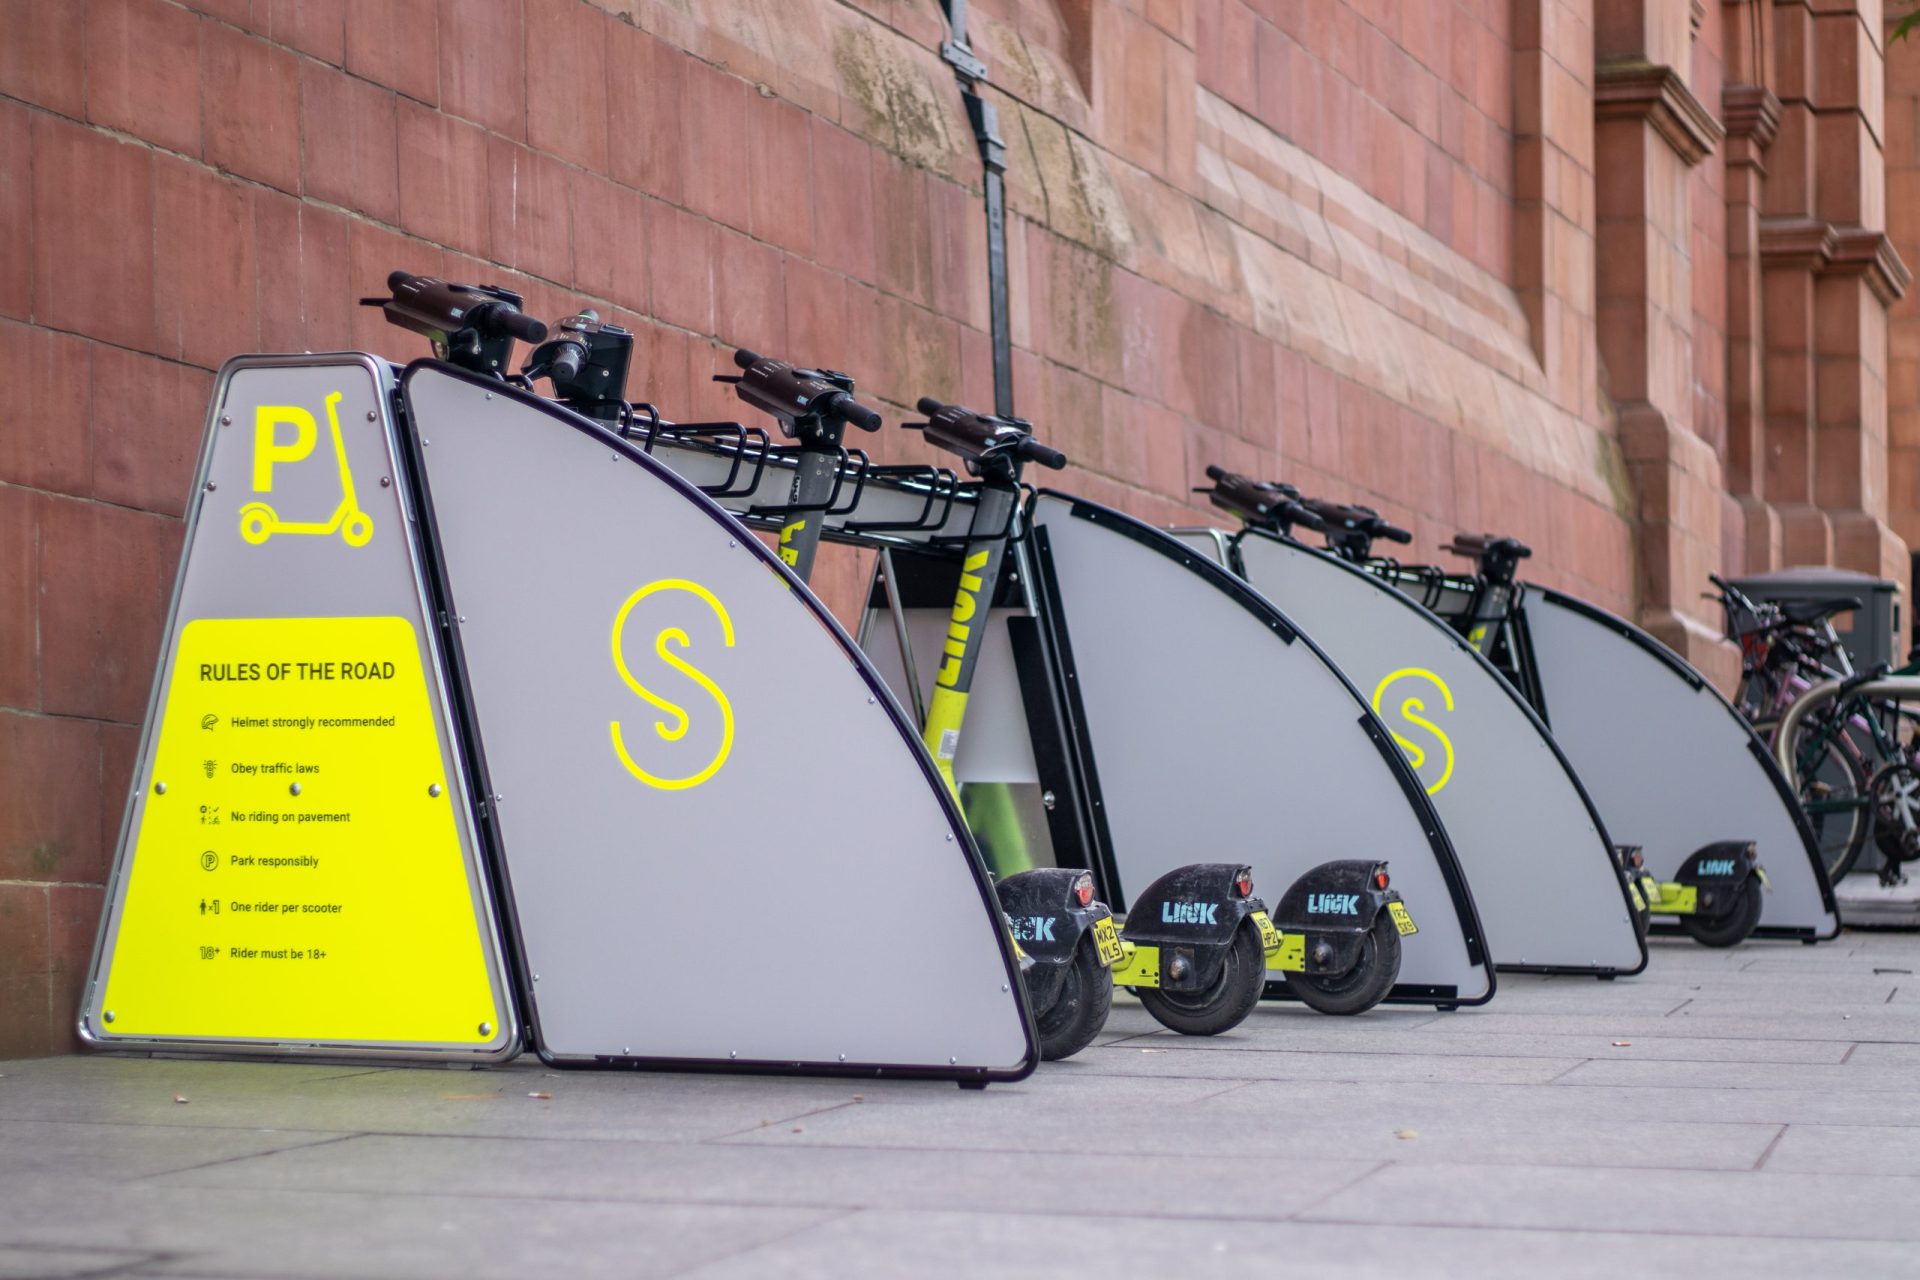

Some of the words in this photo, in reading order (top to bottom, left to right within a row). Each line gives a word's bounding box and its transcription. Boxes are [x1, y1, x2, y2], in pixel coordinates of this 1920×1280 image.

[253, 406, 317, 492] P
[200, 662, 261, 682] RULES
[266, 662, 292, 681] OF
[296, 662, 335, 681] THE
[340, 661, 396, 680] ROAD
[231, 716, 270, 728] Helmet
[272, 715, 315, 730] strongly
[318, 715, 396, 728] recommended
[231, 762, 258, 777] Obey
[260, 762, 293, 774] traffic
[295, 762, 320, 774] laws
[231, 811, 247, 822] No
[248, 810, 279, 825] riding
[281, 812, 295, 822] on
[297, 812, 351, 825] pavement
[230, 855, 256, 867] Park
[257, 855, 319, 870] responsibly
[1697, 859, 1736, 876] LINK
[230, 901, 252, 913] One
[254, 901, 280, 914] rider
[281, 903, 299, 916] per
[301, 903, 343, 914] scooter
[1095, 925, 1115, 945] MX2
[230, 947, 259, 959] Rider
[260, 948, 288, 960] must
[290, 948, 304, 960] be
[306, 948, 328, 960] 18+
[1100, 942, 1121, 961] YL5
